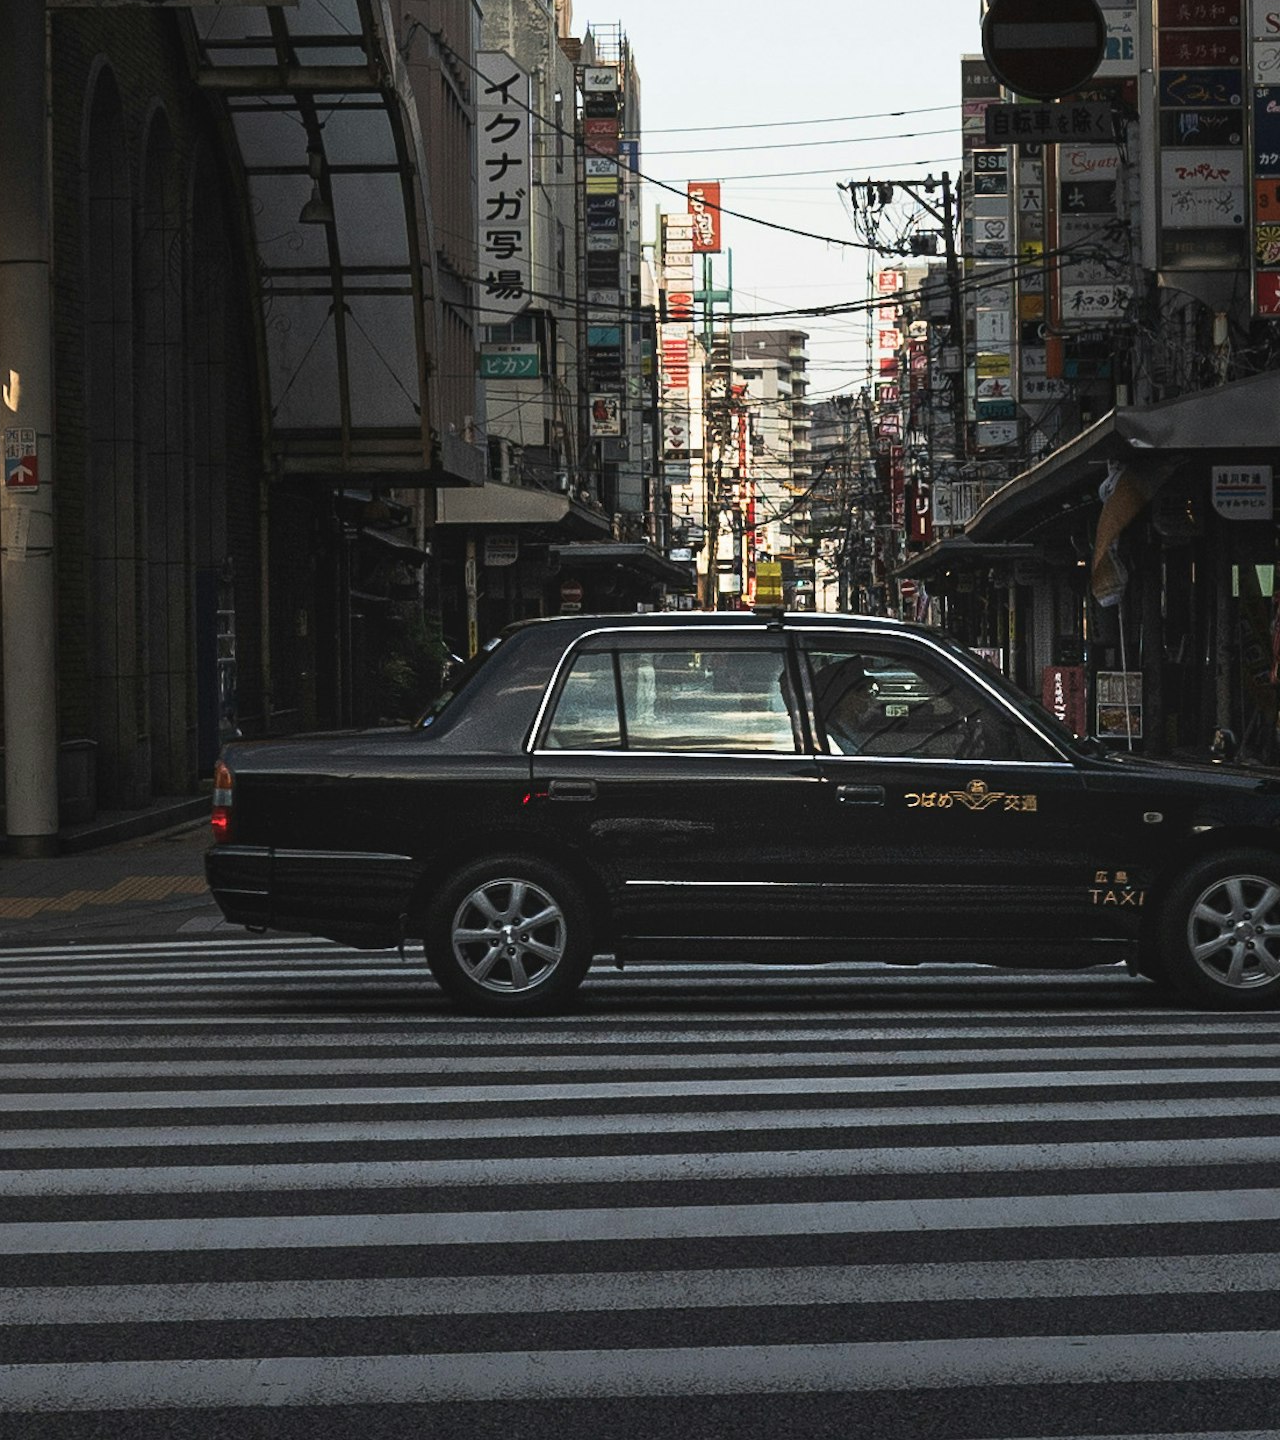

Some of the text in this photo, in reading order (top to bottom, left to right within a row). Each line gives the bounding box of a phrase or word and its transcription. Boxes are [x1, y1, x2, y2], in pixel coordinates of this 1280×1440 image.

[1256, 89, 1270, 99] 3F
[993, 106, 1105, 136] 自転車を除く
[484, 72, 526, 300] イクナガ写場
[903, 791, 1038, 812] つばめ 交通
[1094, 870, 1128, 884] 広島
[1088, 889, 1146, 907] TAXI
